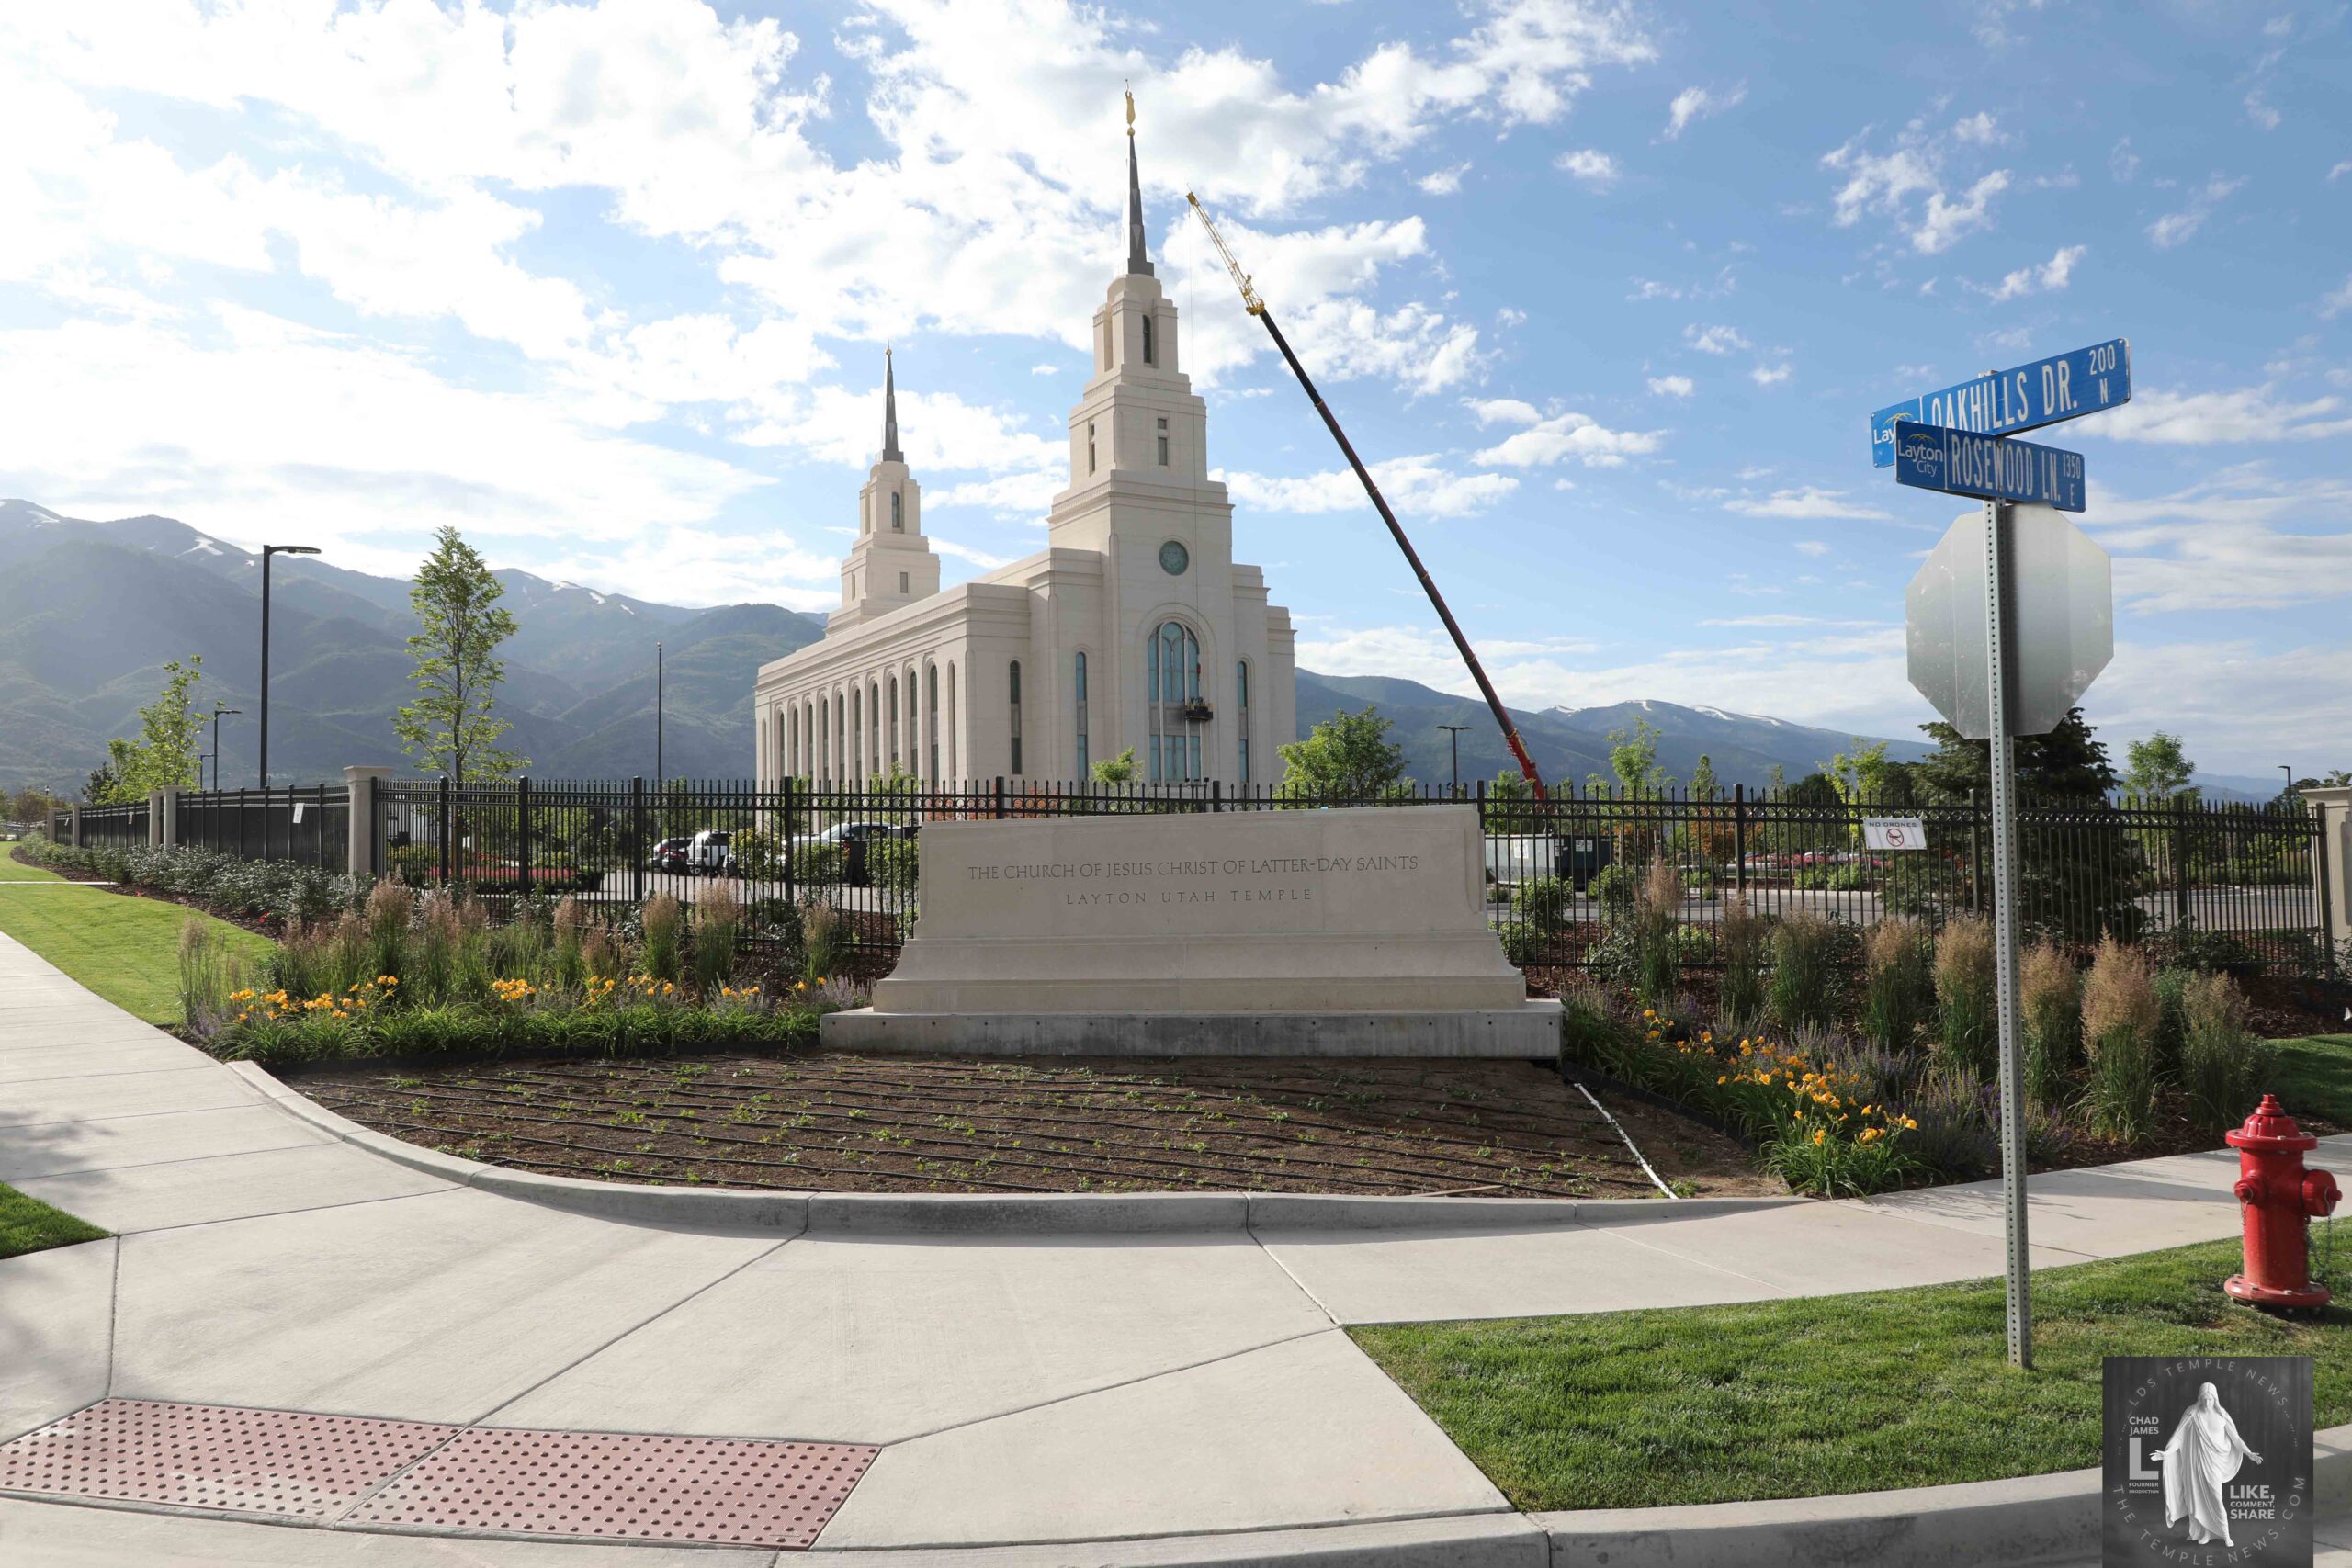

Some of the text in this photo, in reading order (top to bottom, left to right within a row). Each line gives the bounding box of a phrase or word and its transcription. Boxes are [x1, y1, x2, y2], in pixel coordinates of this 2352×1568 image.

[2088, 344, 2116, 375] 200
[1931, 359, 2078, 433] OAKHILLS DR.
[2099, 378, 2109, 404] N
[1873, 427, 1895, 445] Lay
[1898, 439, 1944, 463] Layton
[1917, 460, 1938, 478] City
[1951, 434, 2062, 502] ROSEWOOD LN.
[2063, 453, 2081, 479] 1350
[2070, 483, 2075, 507] E
[967, 855, 1419, 879] THE CHURCH OF JESUS CHRIST OF LATTER-DAY SAINTS
[1066, 888, 1312, 905] LAYTON UTAH TEMPLE
